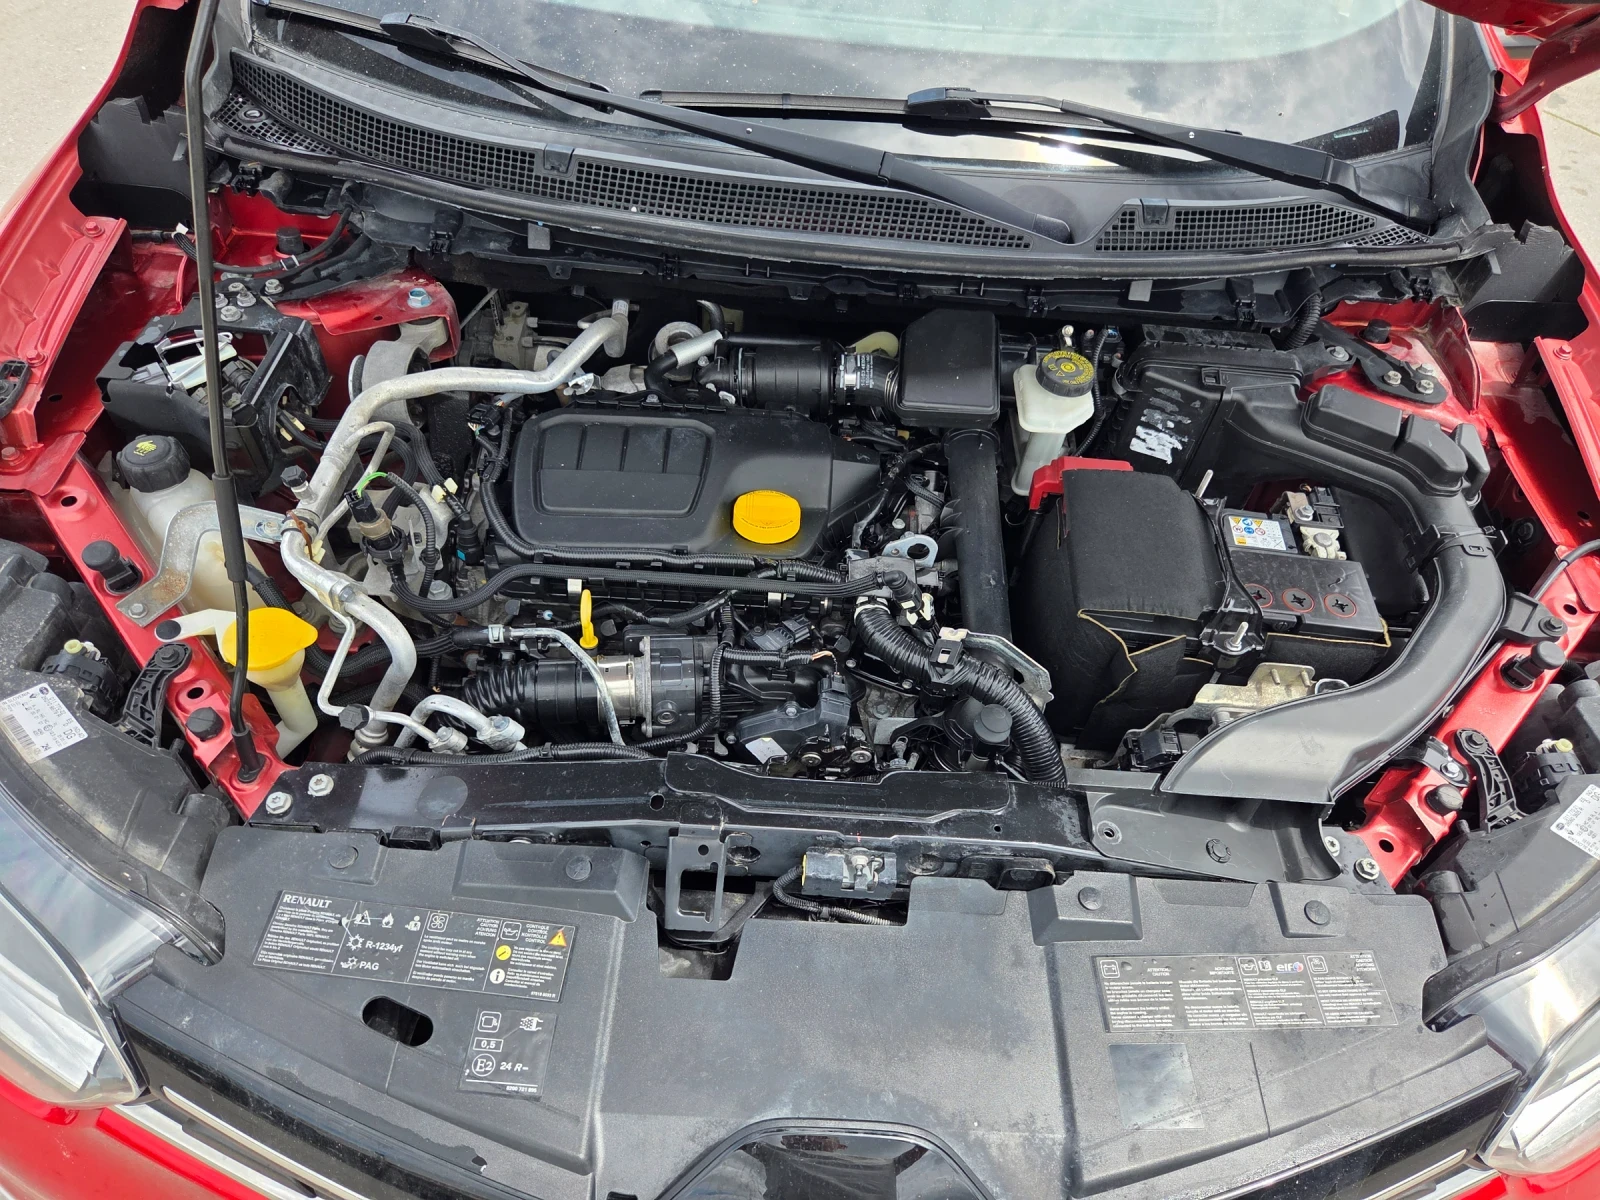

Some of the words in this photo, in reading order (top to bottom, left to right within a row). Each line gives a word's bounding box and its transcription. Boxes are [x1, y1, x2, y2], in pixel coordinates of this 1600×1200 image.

[283, 894, 332, 909] RENAULT
[365, 940, 404, 954] R-1234yf
[359, 961, 380, 971] PAG
[1276, 963, 1294, 972] elf
[481, 1039, 496, 1049] 0,5
[475, 1058, 493, 1072] E2
[500, 1061, 513, 1071] 24
